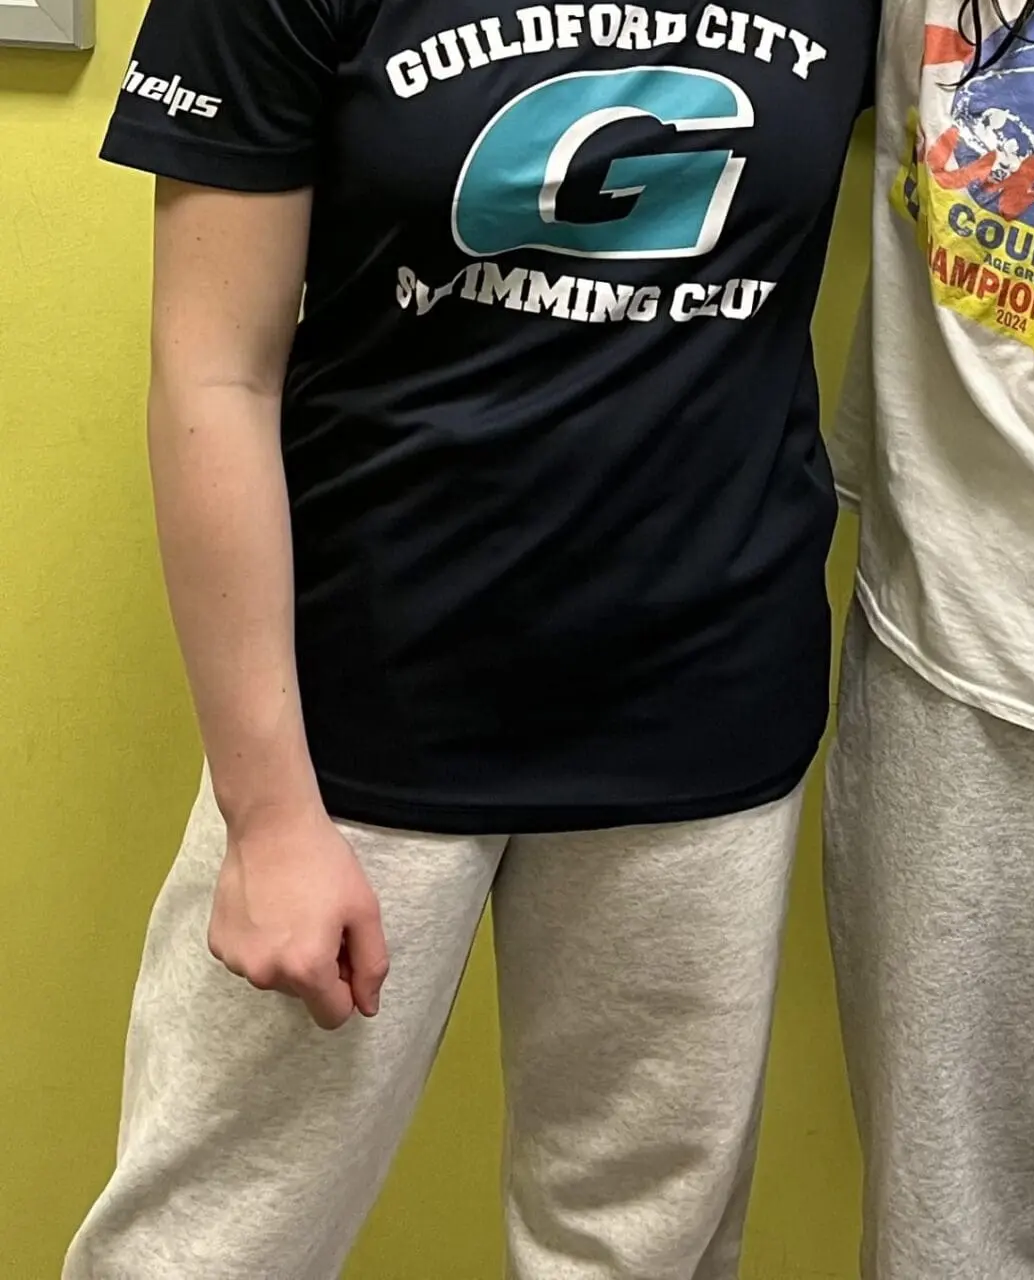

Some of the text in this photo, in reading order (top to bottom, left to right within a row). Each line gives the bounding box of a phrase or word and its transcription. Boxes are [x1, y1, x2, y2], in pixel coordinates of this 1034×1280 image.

[386, 4, 830, 99] GUILDFORD CITY
[451, 65, 755, 260] G
[983, 252, 1013, 276] AGE
[996, 310, 1027, 333] 2024
